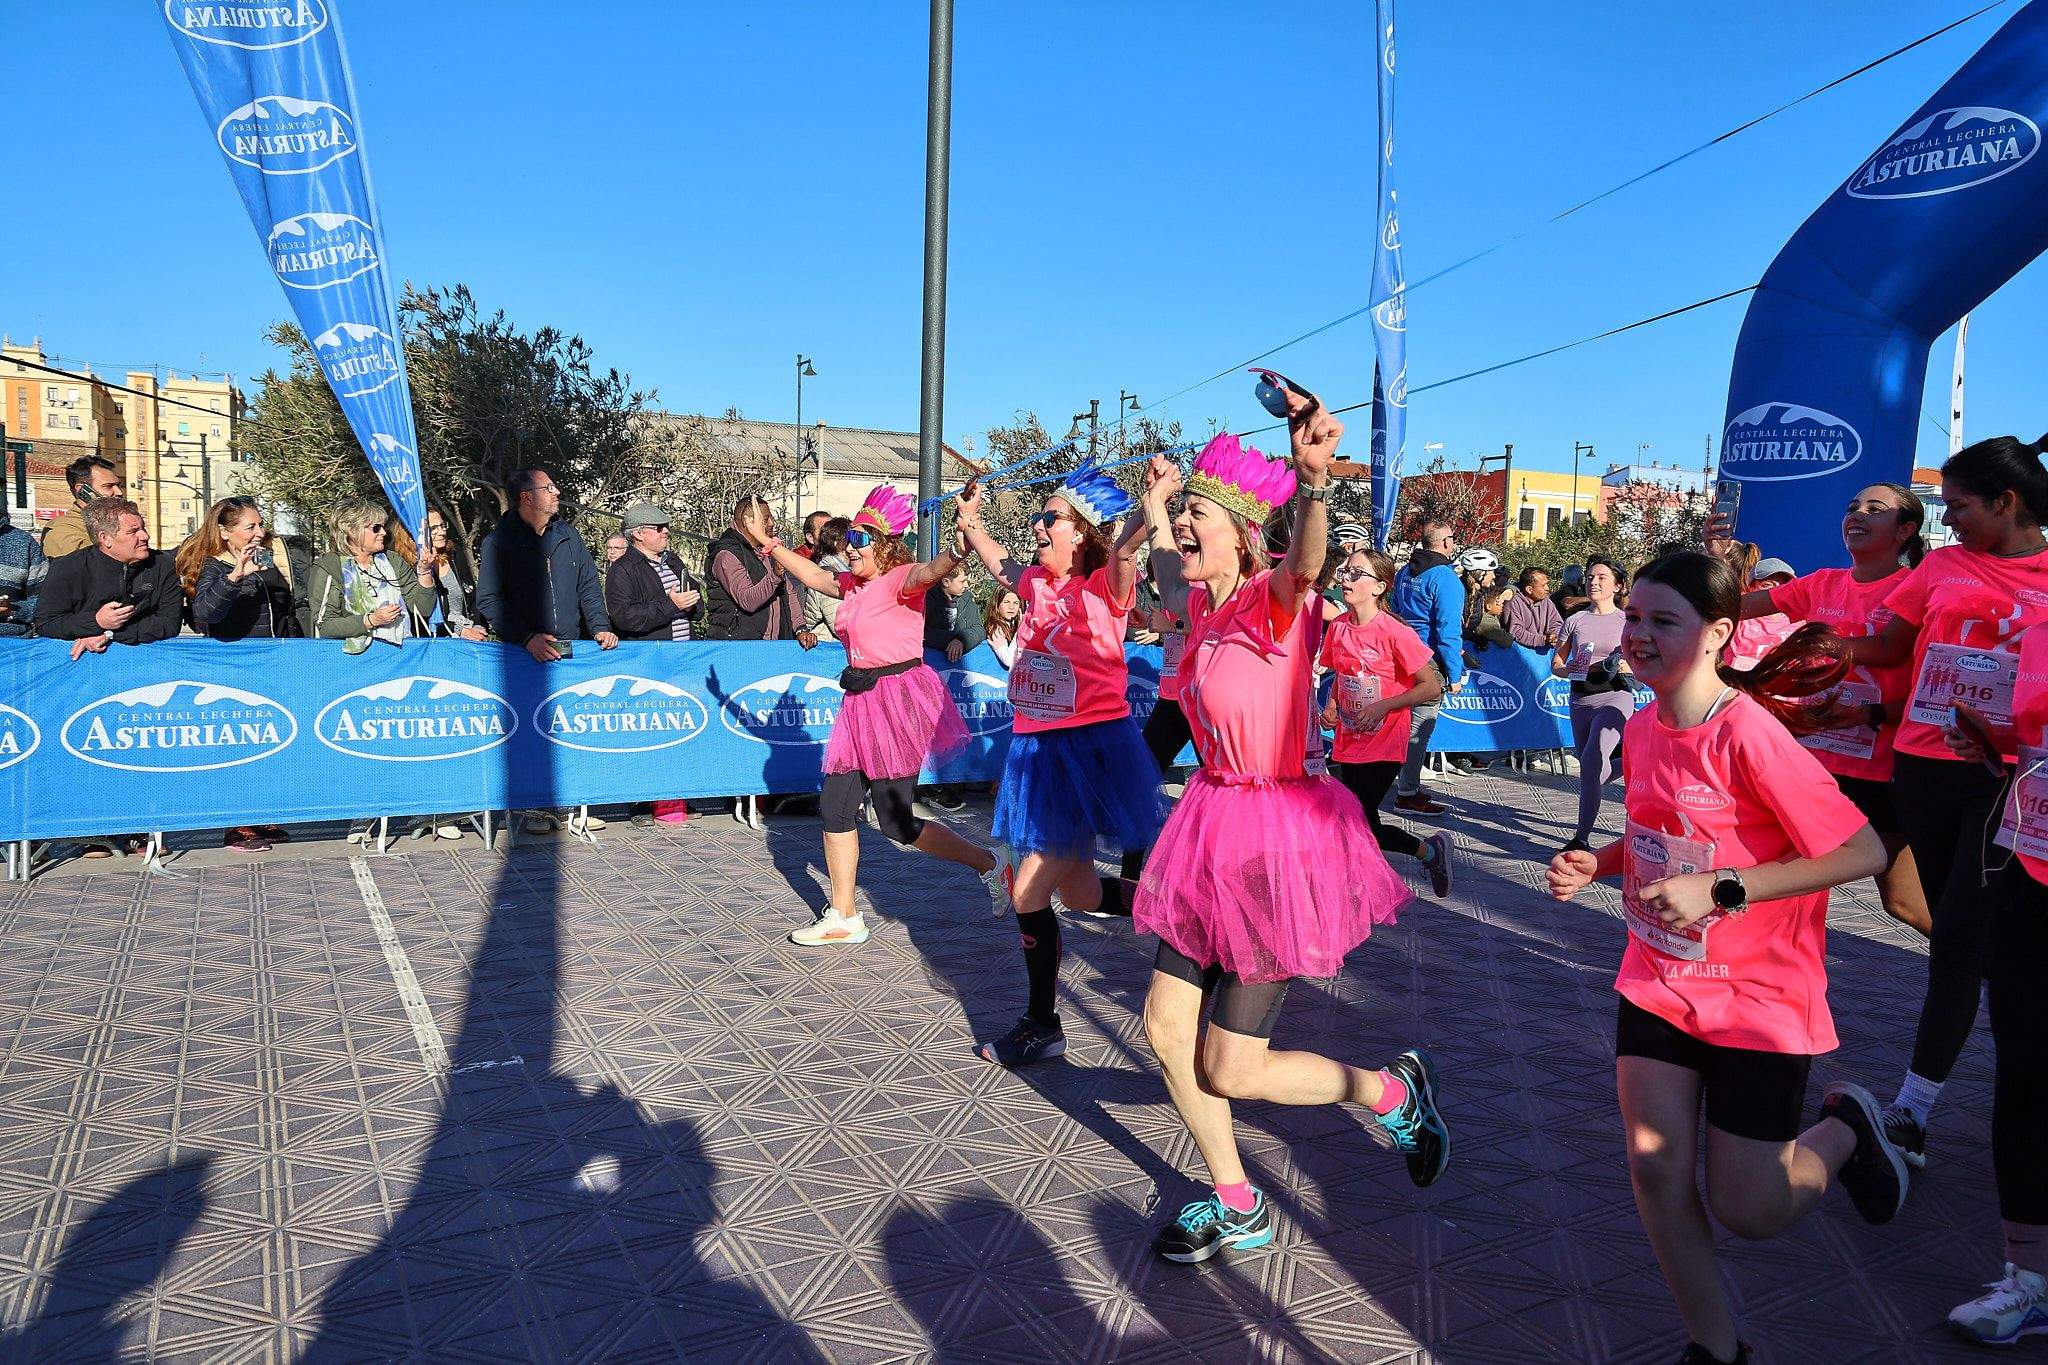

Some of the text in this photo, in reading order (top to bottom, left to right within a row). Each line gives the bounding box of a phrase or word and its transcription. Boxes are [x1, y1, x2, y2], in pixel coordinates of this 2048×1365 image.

[1886, 124, 2017, 160] CENTRAL LECHERA
[1853, 137, 2022, 190] ASTURIANA
[1735, 428, 1844, 439] CENTRAL LECHERA
[1720, 435, 1847, 463] ASTURIANA
[1960, 658, 1998, 670] ASTURIANA
[1030, 681, 1055, 695] 016
[1952, 682, 1994, 701] 016
[363, 702, 498, 716] CENTRAL LECHERA
[574, 699, 689, 710] CENTRAL LECHERA
[809, 695, 843, 705] LECH
[1440, 692, 1518, 710] ASTURIANA
[119, 706, 274, 722] CENTRAL LECHERA
[735, 700, 840, 728] ASTURIA
[955, 700, 1014, 719] RIANA
[332, 708, 505, 742] ASTURIANA
[548, 704, 696, 735] ASTURIANA
[80, 715, 281, 751] ASTURIANA
[1677, 793, 1726, 807] ASTURIANA
[1655, 934, 1689, 953] Santander
[1682, 963, 1730, 979] MUJER
